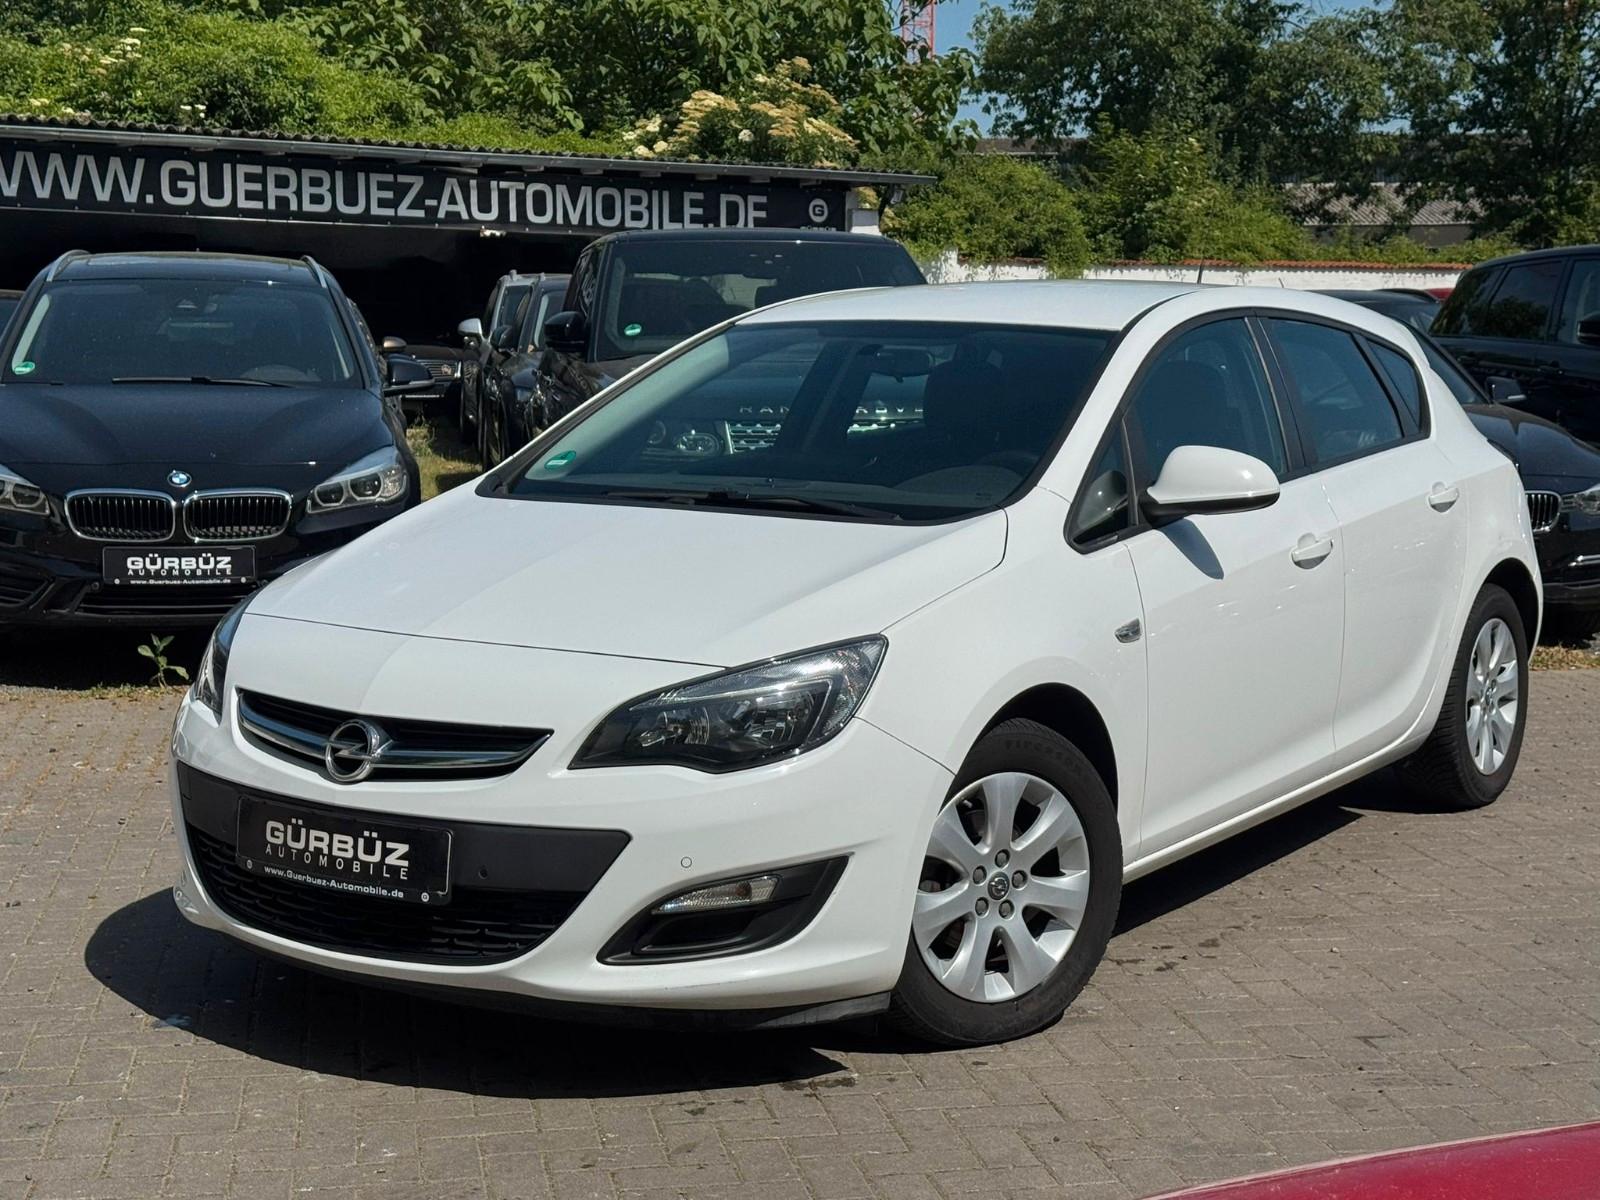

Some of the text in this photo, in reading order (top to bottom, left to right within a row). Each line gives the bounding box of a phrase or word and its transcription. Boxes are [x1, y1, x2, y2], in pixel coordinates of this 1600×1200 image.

[126, 553, 232, 570] GÜRBÜZ
[265, 818, 410, 867] GÜRBÜZ
[265, 844, 408, 880] AUTOMOBILE
